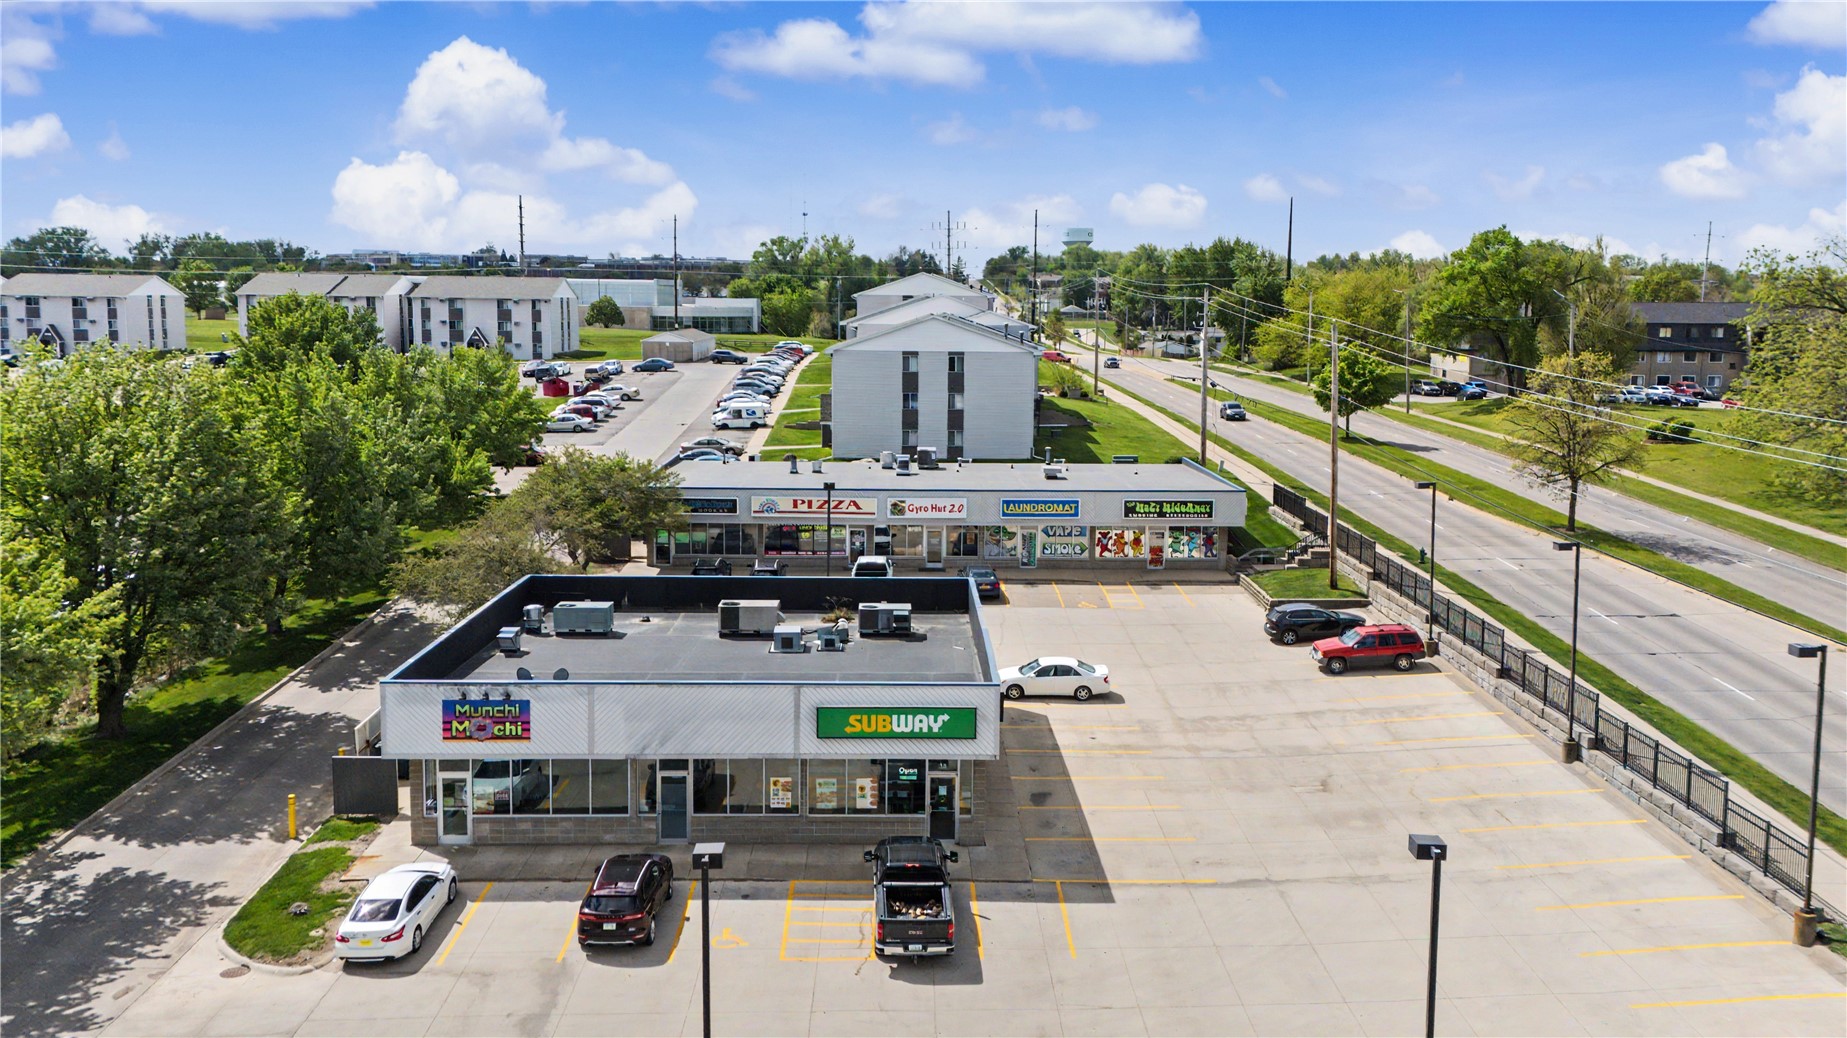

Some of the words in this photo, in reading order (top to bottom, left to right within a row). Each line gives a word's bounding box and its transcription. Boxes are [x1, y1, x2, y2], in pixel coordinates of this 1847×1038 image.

[792, 498, 863, 511] PIZZA
[907, 503, 929, 515] Gyro
[931, 503, 947, 513] Hut
[948, 503, 964, 514] 2.0
[1003, 502, 1077, 514] LAUNDROMAT
[455, 703, 521, 718] Munchi
[844, 712, 950, 734] SUBWAY
